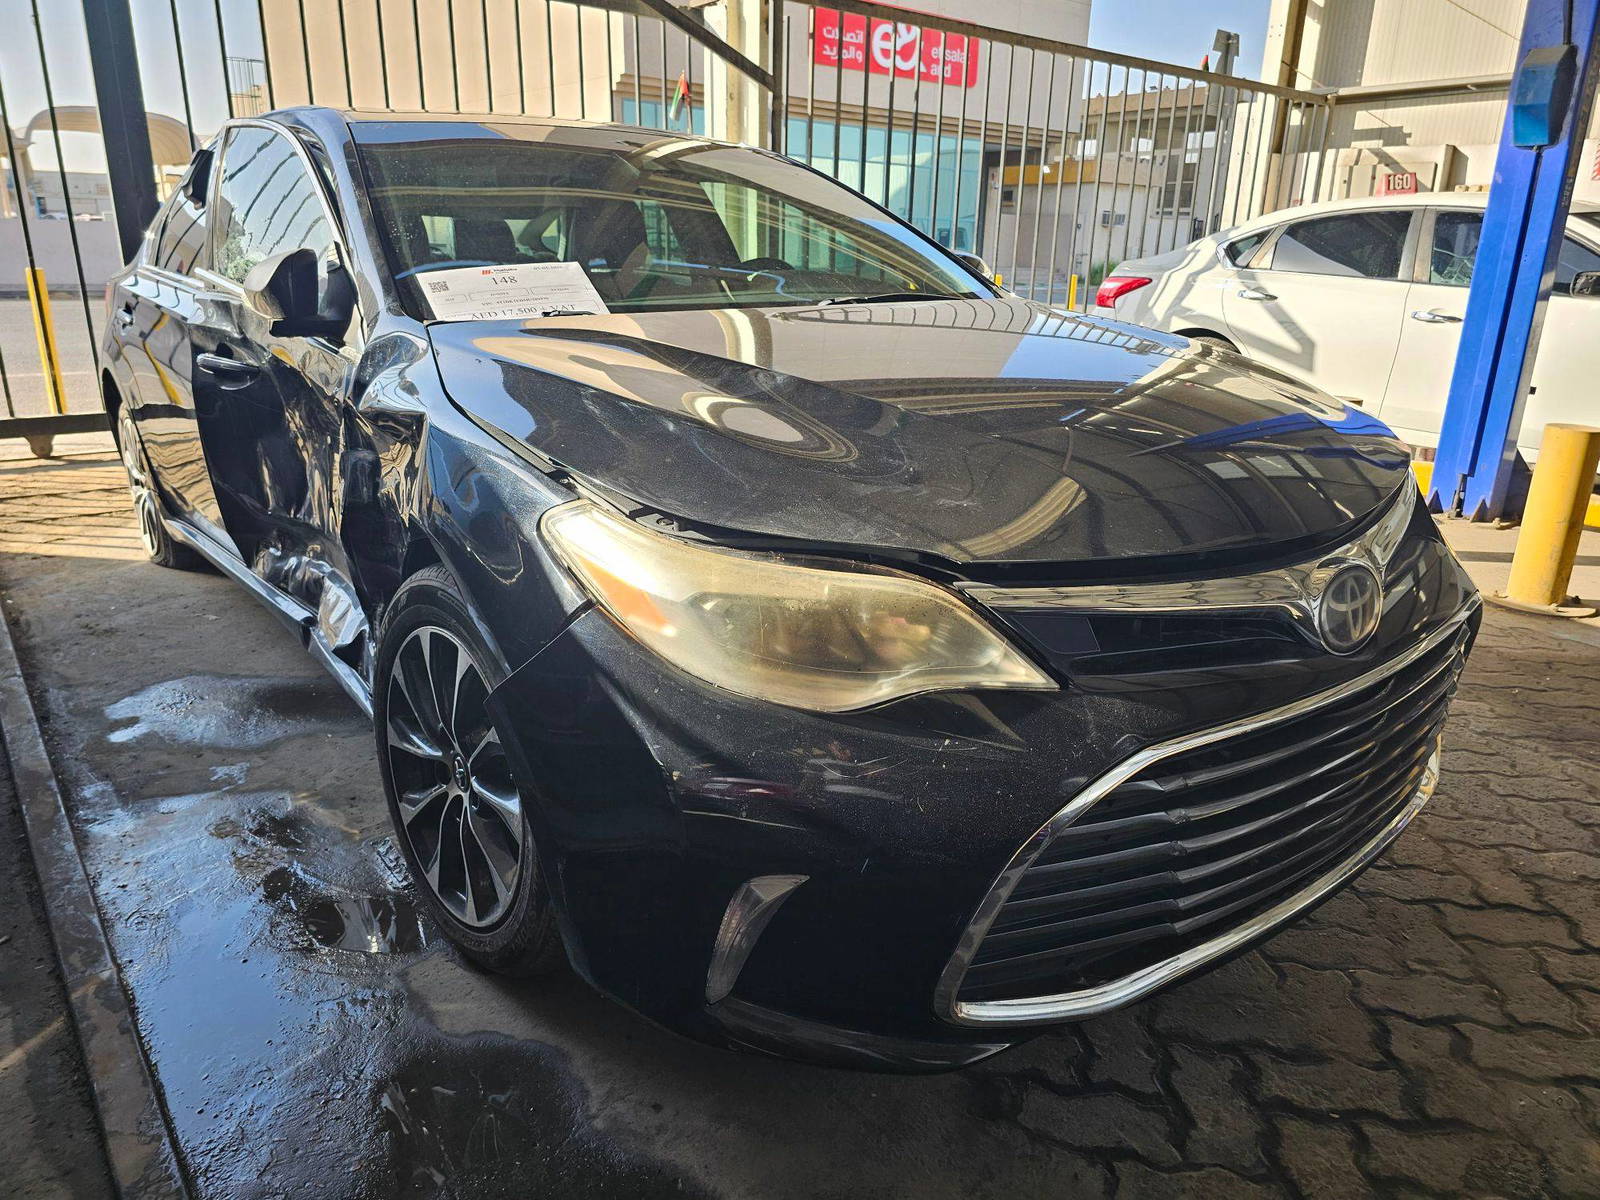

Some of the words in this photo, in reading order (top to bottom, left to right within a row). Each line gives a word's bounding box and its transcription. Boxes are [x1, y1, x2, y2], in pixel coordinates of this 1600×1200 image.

[822, 45, 863, 63] والميد
[931, 46, 971, 65] esala
[1389, 173, 1411, 191] 160
[492, 275, 518, 285] 148
[472, 311, 498, 320] AED
[502, 307, 538, 316] 17,500
[550, 303, 576, 311] VAT
